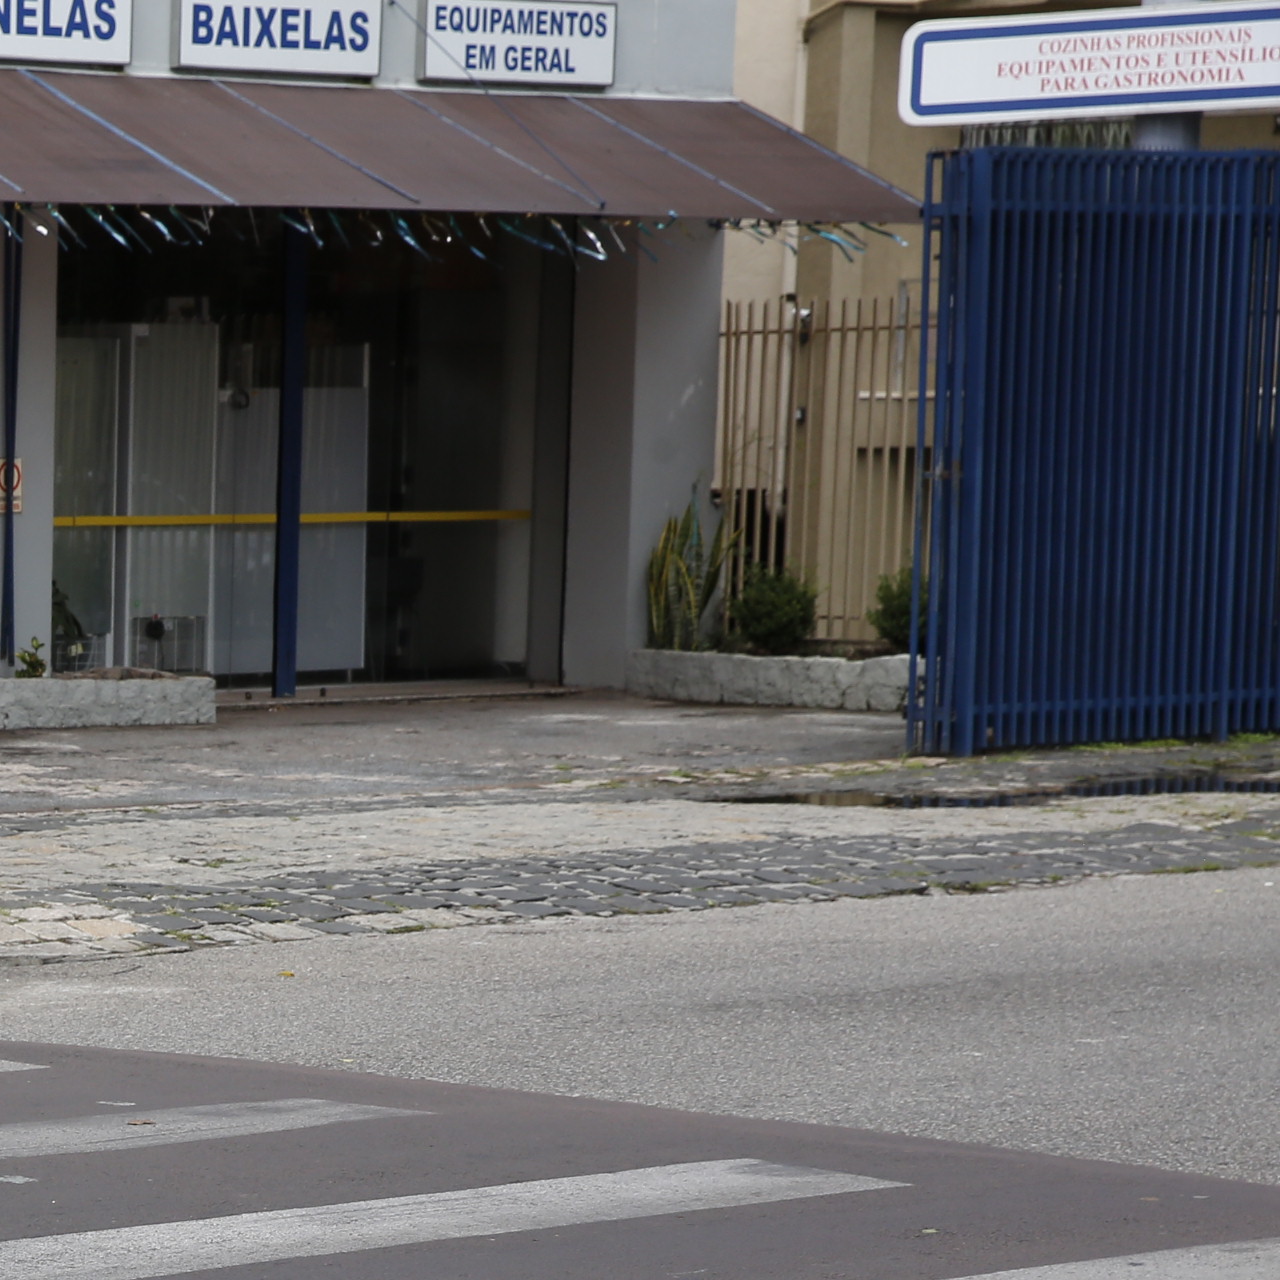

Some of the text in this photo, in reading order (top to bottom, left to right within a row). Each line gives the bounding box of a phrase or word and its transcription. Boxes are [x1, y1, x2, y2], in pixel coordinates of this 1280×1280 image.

[192, 4, 369, 51] BAIXELAS
[435, 6, 607, 38] EQUIPAMENTOS
[1038, 28, 1252, 54] COZINHAS PROFISSIONAIS
[465, 44, 575, 73] EM GERAL
[996, 54, 1150, 79] EQUIPAMENTOS
[1156, 53, 1167, 67] E
[1040, 67, 1245, 92] PARA GASTRONOMIA
